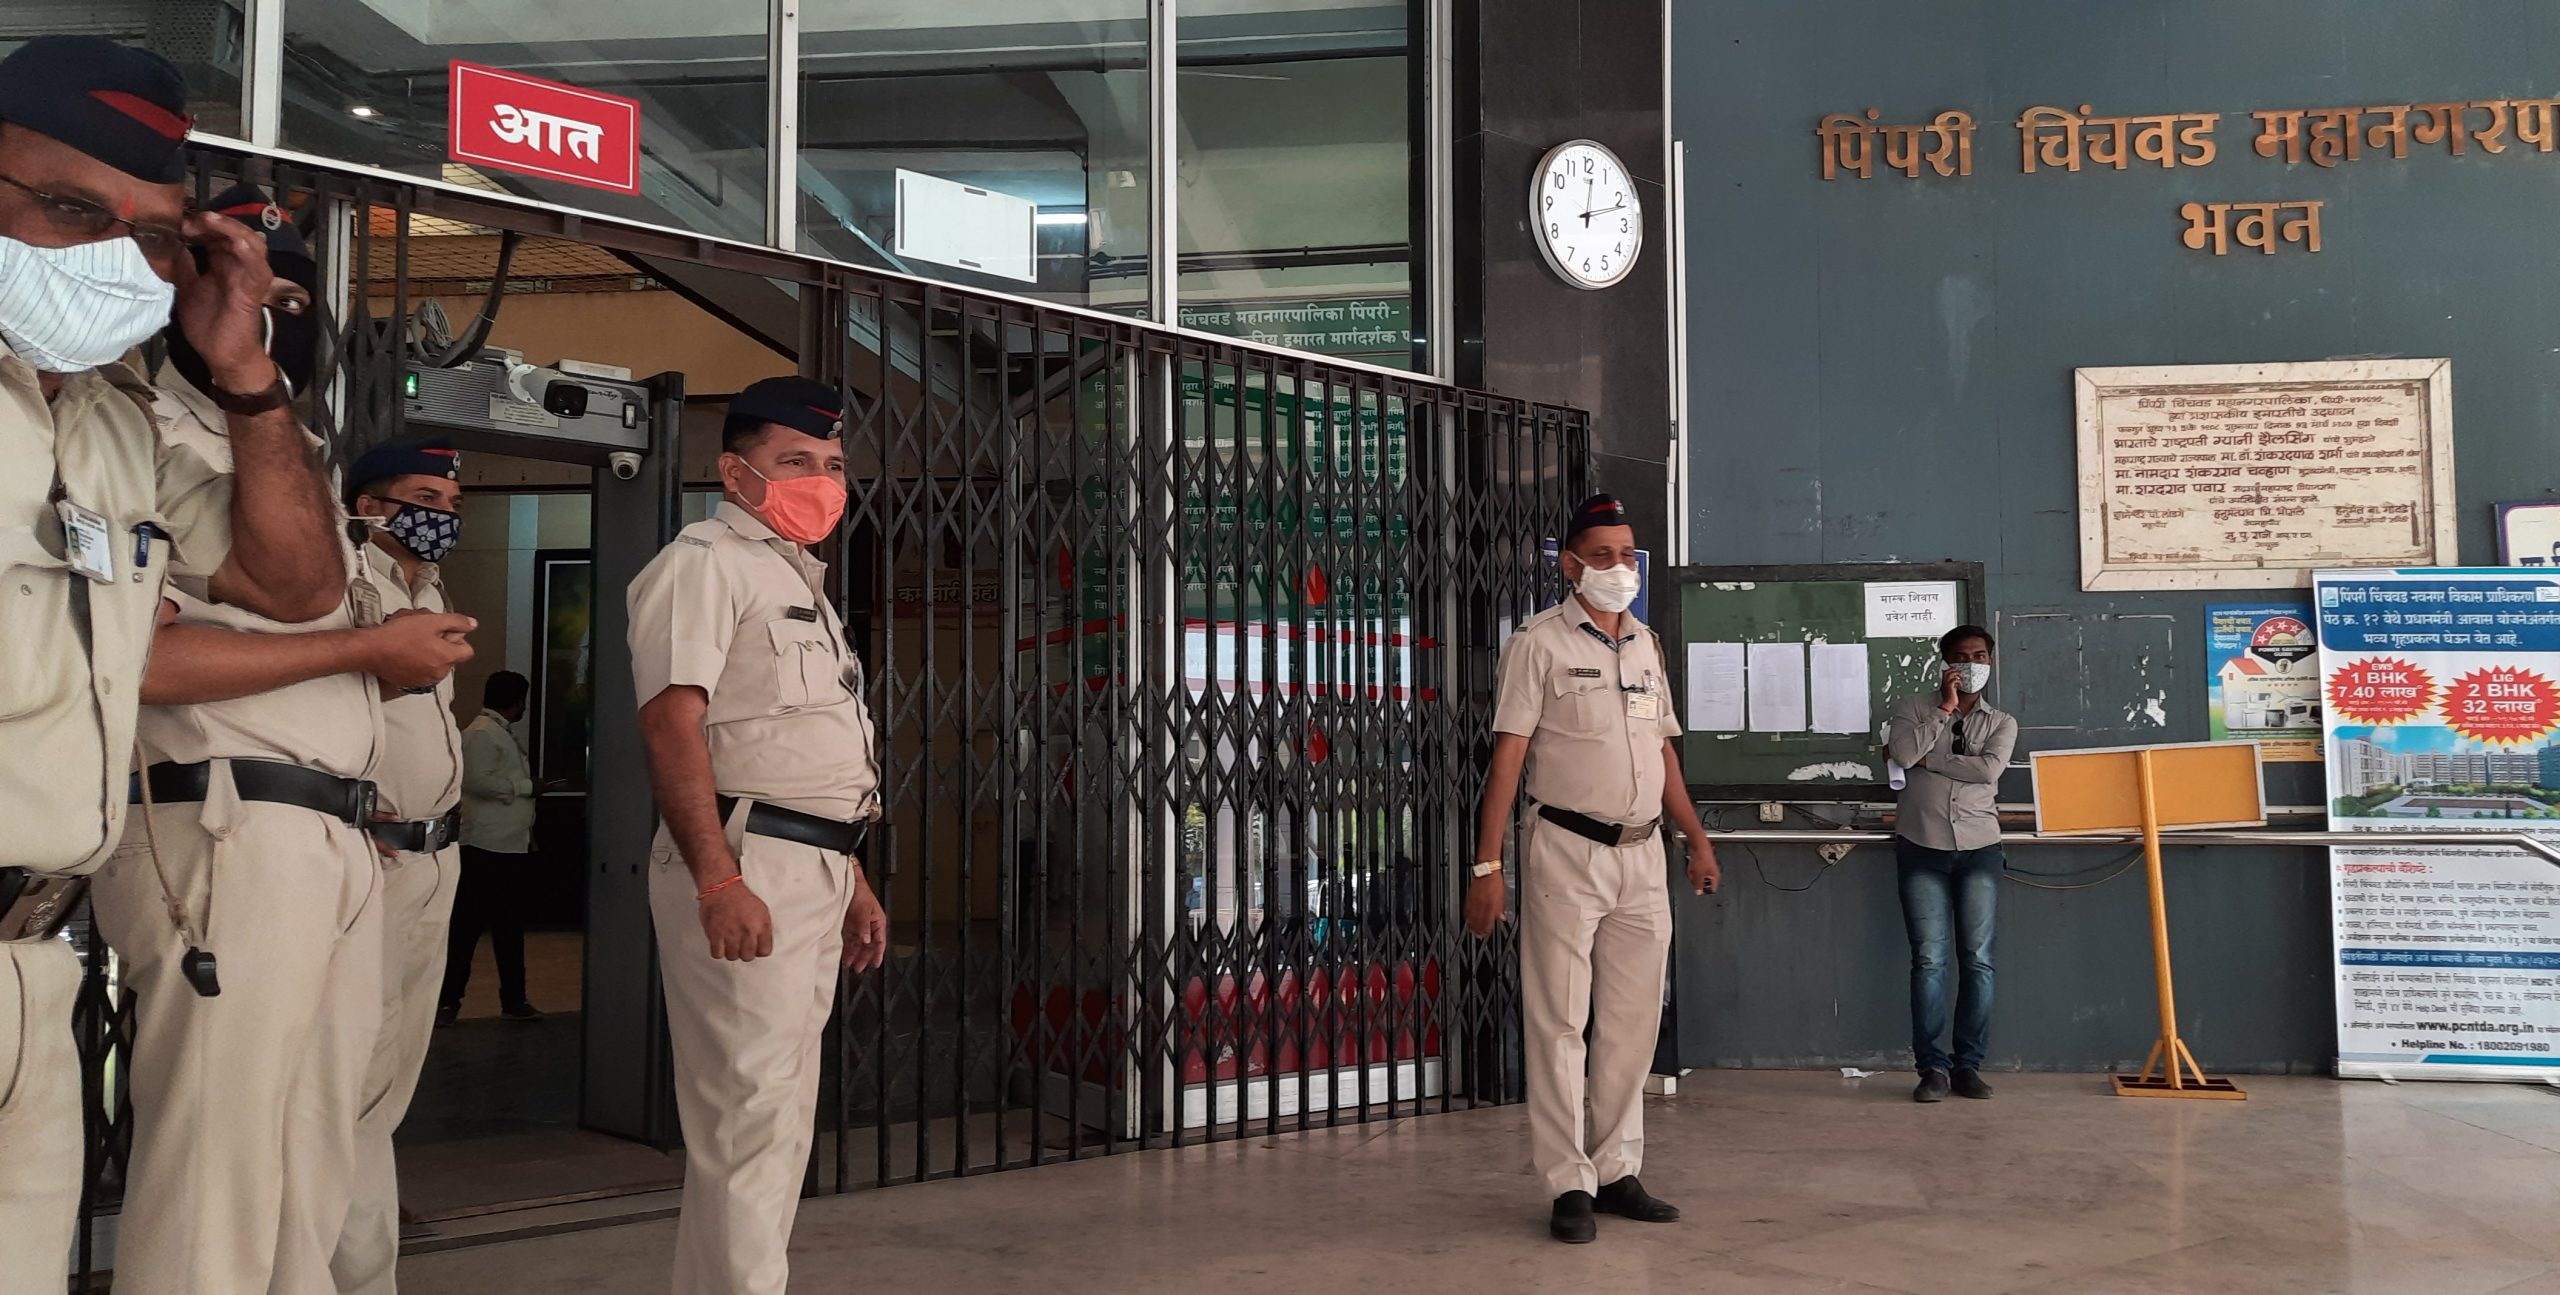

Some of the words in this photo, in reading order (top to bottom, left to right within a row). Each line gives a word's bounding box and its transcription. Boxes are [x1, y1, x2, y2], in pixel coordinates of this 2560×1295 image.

[489, 103, 605, 165] आत
[1818, 108, 1976, 180] पिंपरी
[2017, 103, 2221, 174] चिंचवड
[2252, 98, 2560, 168] महानगरप
[1566, 158, 1576, 178] 11
[1583, 156, 1594, 174] 12
[1553, 171, 1565, 190] 10
[1602, 168, 1607, 185] 1
[1545, 195, 1553, 211] 9
[1615, 191, 1625, 207] 2
[1551, 222, 1558, 239] 8
[1620, 217, 1628, 233] 3
[2180, 200, 2324, 256] भवन
[1567, 246, 1575, 262] 7
[1614, 241, 1622, 256] 4
[1583, 257, 1590, 273] 6
[1601, 255, 1609, 271] 5
[1179, 307, 1230, 326] चिंचवड
[1236, 303, 1344, 324] महानगरपालिका
[2192, 483, 2226, 493] पवार
[2340, 586, 2366, 603] पिंपरी
[2369, 586, 2408, 603] चिंचवड
[2410, 591, 2445, 604] नवनगर
[2449, 587, 2483, 603] विकास
[2485, 587, 2534, 603] प्राधिकरण
[2323, 611, 2340, 625] पेठ
[2404, 609, 2452, 626] प्रधानमंत्री
[2457, 614, 2493, 626] आवास
[2351, 673, 2360, 683] 1
[2367, 672, 2408, 684] BHK
[2492, 674, 2514, 682] LIG
[2337, 686, 2375, 698] 7.40
[2467, 684, 2481, 697] 2
[2487, 684, 2536, 697] BHK
[2462, 700, 2487, 713] 32
[2416, 1021, 2534, 1035] www.pcntda.org.in
[2402, 1039, 2446, 1050] Helpline
[2449, 1040, 2467, 1050] No.
